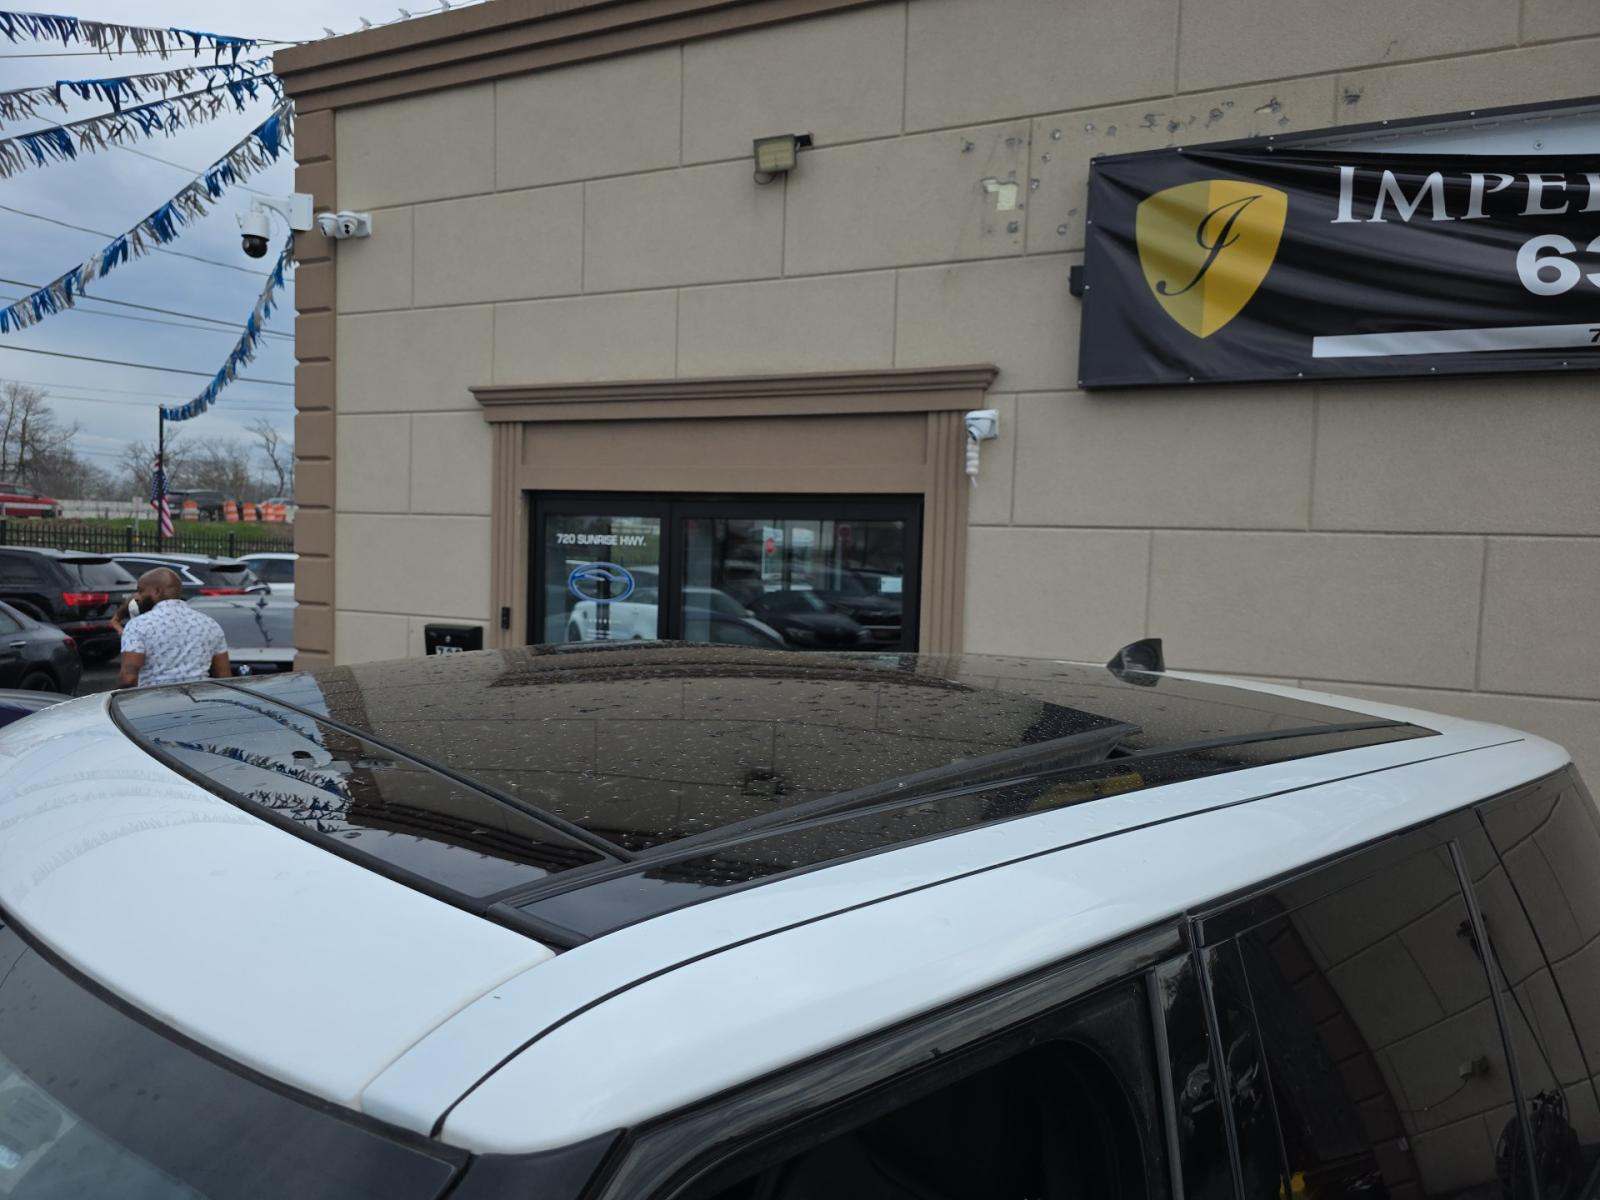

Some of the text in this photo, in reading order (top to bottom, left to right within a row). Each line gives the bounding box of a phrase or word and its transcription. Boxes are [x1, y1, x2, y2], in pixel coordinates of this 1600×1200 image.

[1516, 234, 1600, 296] 6
[556, 532, 646, 547] 720 SUNRISE HWY.
